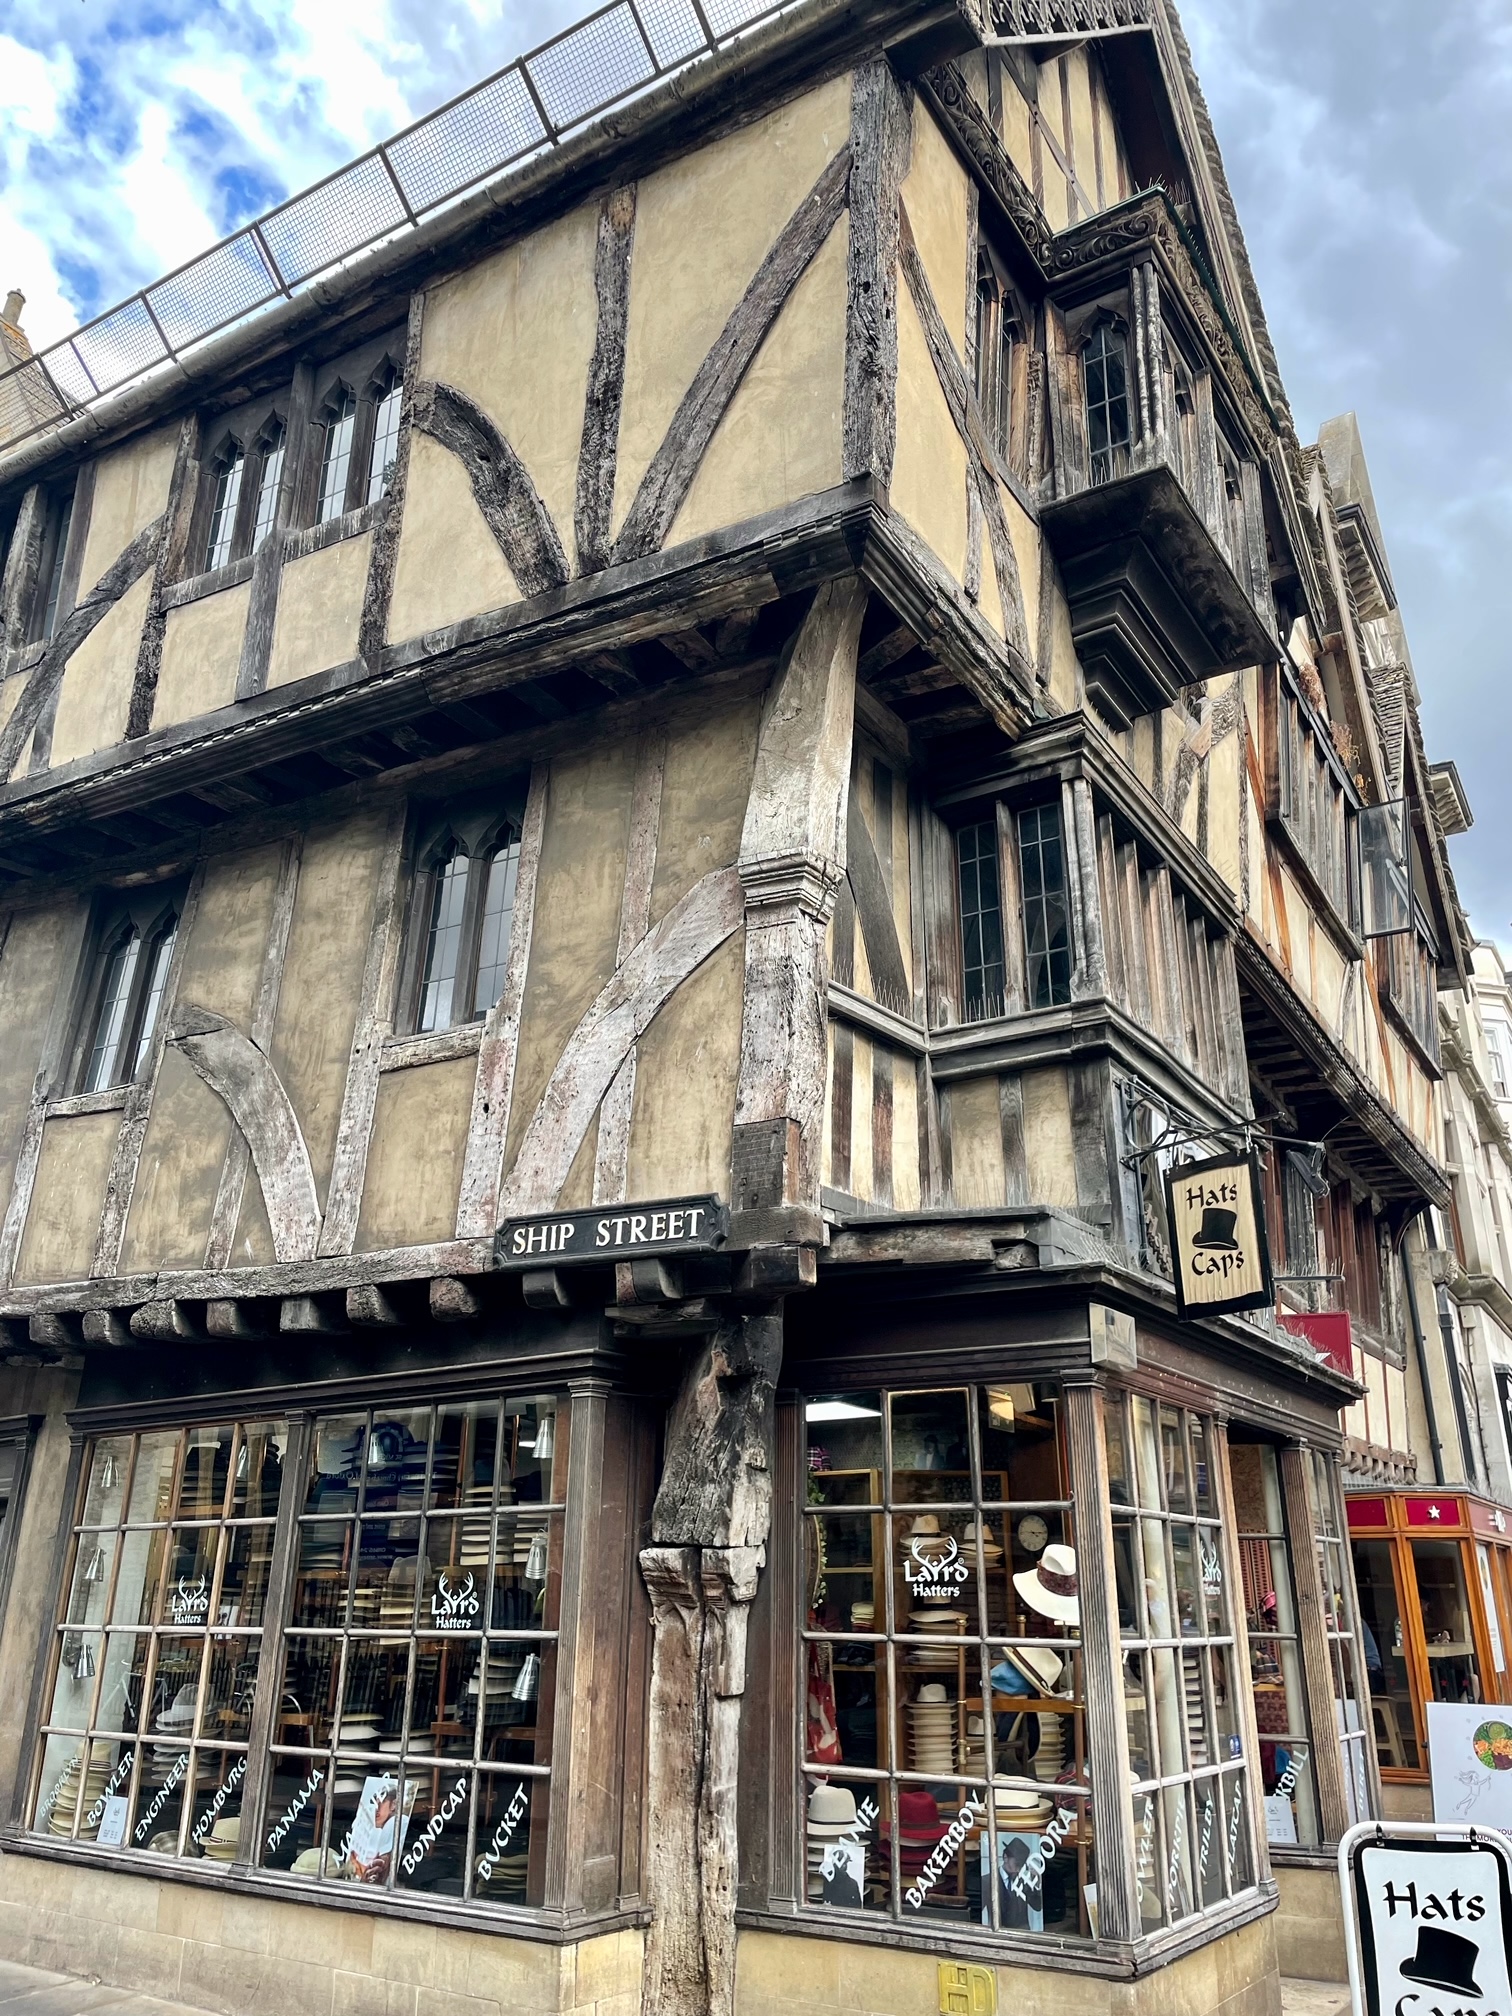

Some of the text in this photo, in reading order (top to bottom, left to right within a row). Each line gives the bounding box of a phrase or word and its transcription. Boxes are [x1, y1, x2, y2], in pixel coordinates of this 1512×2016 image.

[1186, 1182, 1238, 1210] Hats
[512, 1208, 705, 1255] SHIP STREET
[1191, 1250, 1245, 1278] Caps
[903, 1556, 969, 1582] Laird
[912, 1582, 961, 1597] Hatters
[171, 1593, 209, 1613] Laird
[174, 1613, 202, 1625] Hatters
[431, 1592, 480, 1616] Laird
[436, 1616, 472, 1630] Hatters
[40, 1754, 79, 1818] BROOKLYN
[87, 1751, 134, 1828] BOWLER
[134, 1753, 189, 1842] ENGINEER
[192, 1756, 248, 1845] HOMBURG
[266, 1768, 325, 1852] PANAMA
[402, 1777, 469, 1875] BONDCAP
[477, 1782, 529, 1881] BUCKET
[905, 1789, 986, 1909] BAKERBOY
[1137, 1798, 1154, 1903] OWLER
[1011, 1807, 1079, 1901] FEDORA
[1382, 1880, 1486, 1922] Hats
